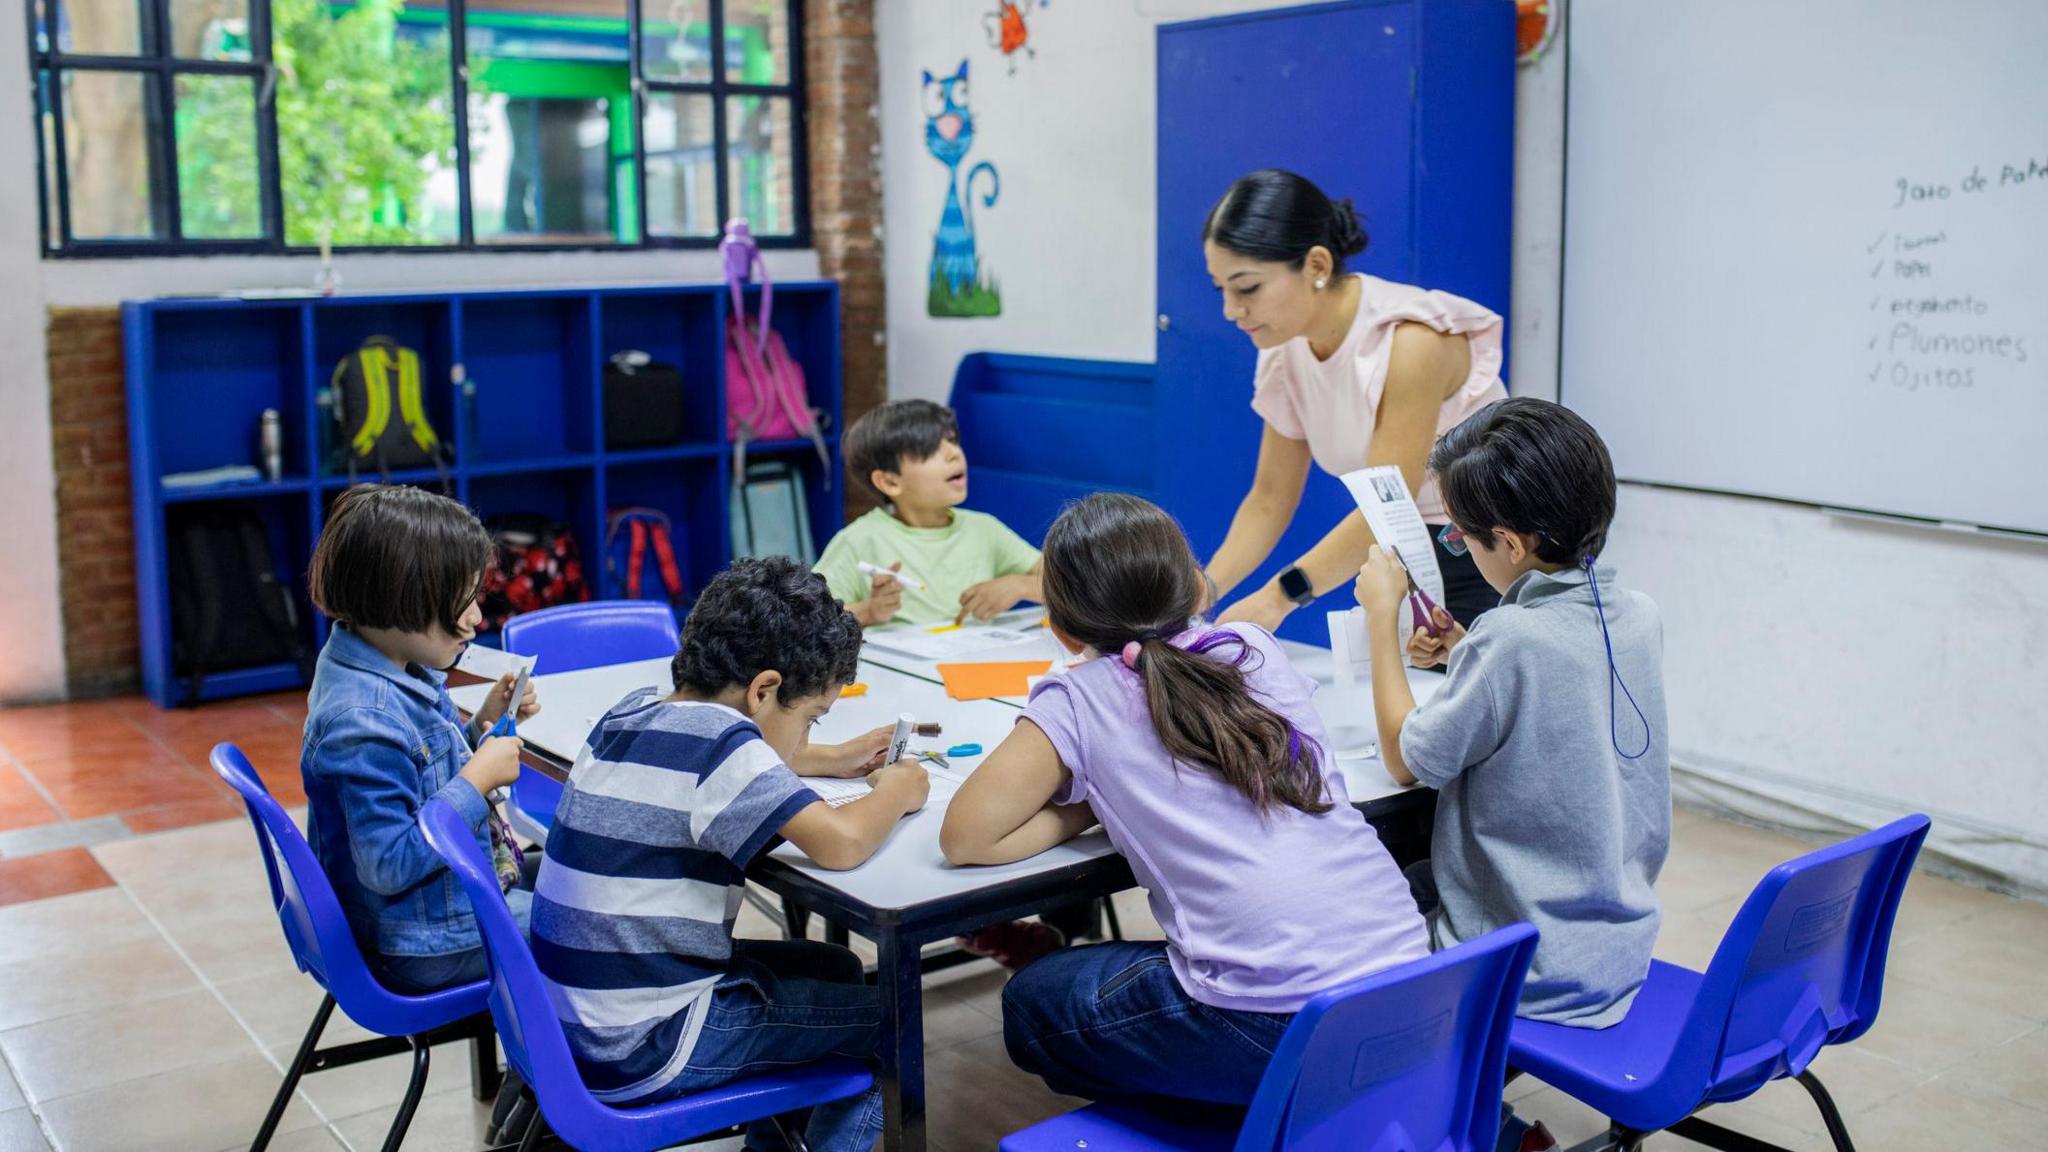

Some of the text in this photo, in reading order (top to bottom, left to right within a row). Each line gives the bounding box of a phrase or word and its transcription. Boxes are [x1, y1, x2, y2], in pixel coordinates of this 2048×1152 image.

[1961, 164, 1988, 192] de
[1888, 321, 2028, 362] Plumones
[1890, 360, 1974, 391] Ojitos
